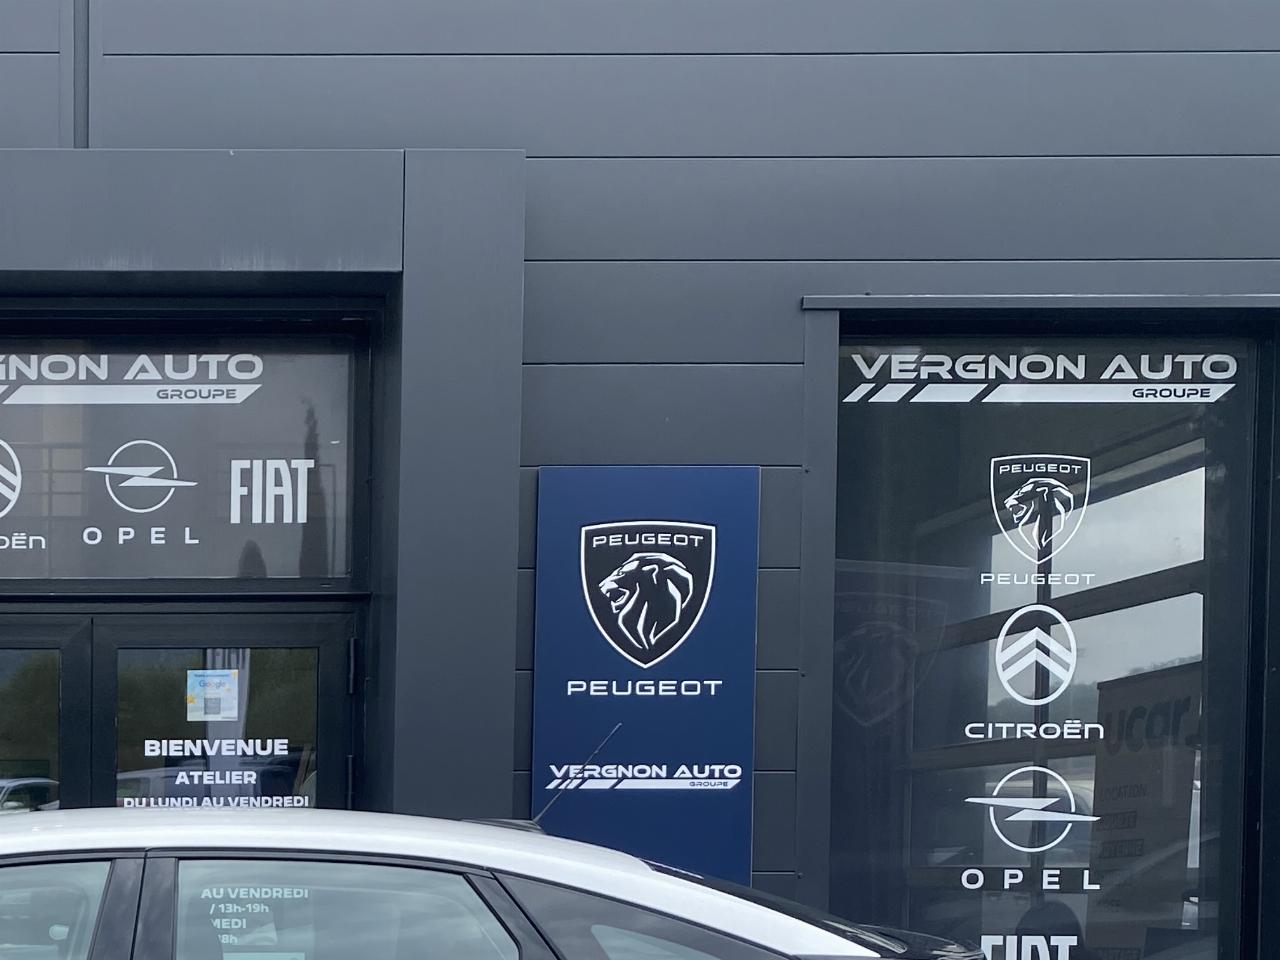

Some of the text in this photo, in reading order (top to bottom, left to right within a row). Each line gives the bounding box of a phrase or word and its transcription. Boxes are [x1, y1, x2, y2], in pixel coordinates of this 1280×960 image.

[123, 353, 264, 380] AUTO
[851, 354, 1238, 380] VERGNON AUTO
[156, 388, 237, 400] GROUPE
[1132, 387, 1211, 398] GROUPE
[999, 463, 1082, 474] PEUGEOT
[231, 459, 315, 524] FIAT
[83, 527, 200, 545] OPEL
[592, 533, 704, 548] PEUGEOT
[980, 573, 1095, 585] PEUGEOT
[567, 680, 723, 696] PEUGEOT
[144, 739, 289, 757] BIENVENUE
[174, 771, 257, 785] ATELIER
[549, 765, 742, 779] VERGNON AUTO
[124, 796, 309, 807] DU LUNDI AU VENDREDI
[961, 869, 1101, 890] OPEL
[201, 888, 309, 898] AU VENDREDI
[218, 904, 269, 913] 13h-19h
